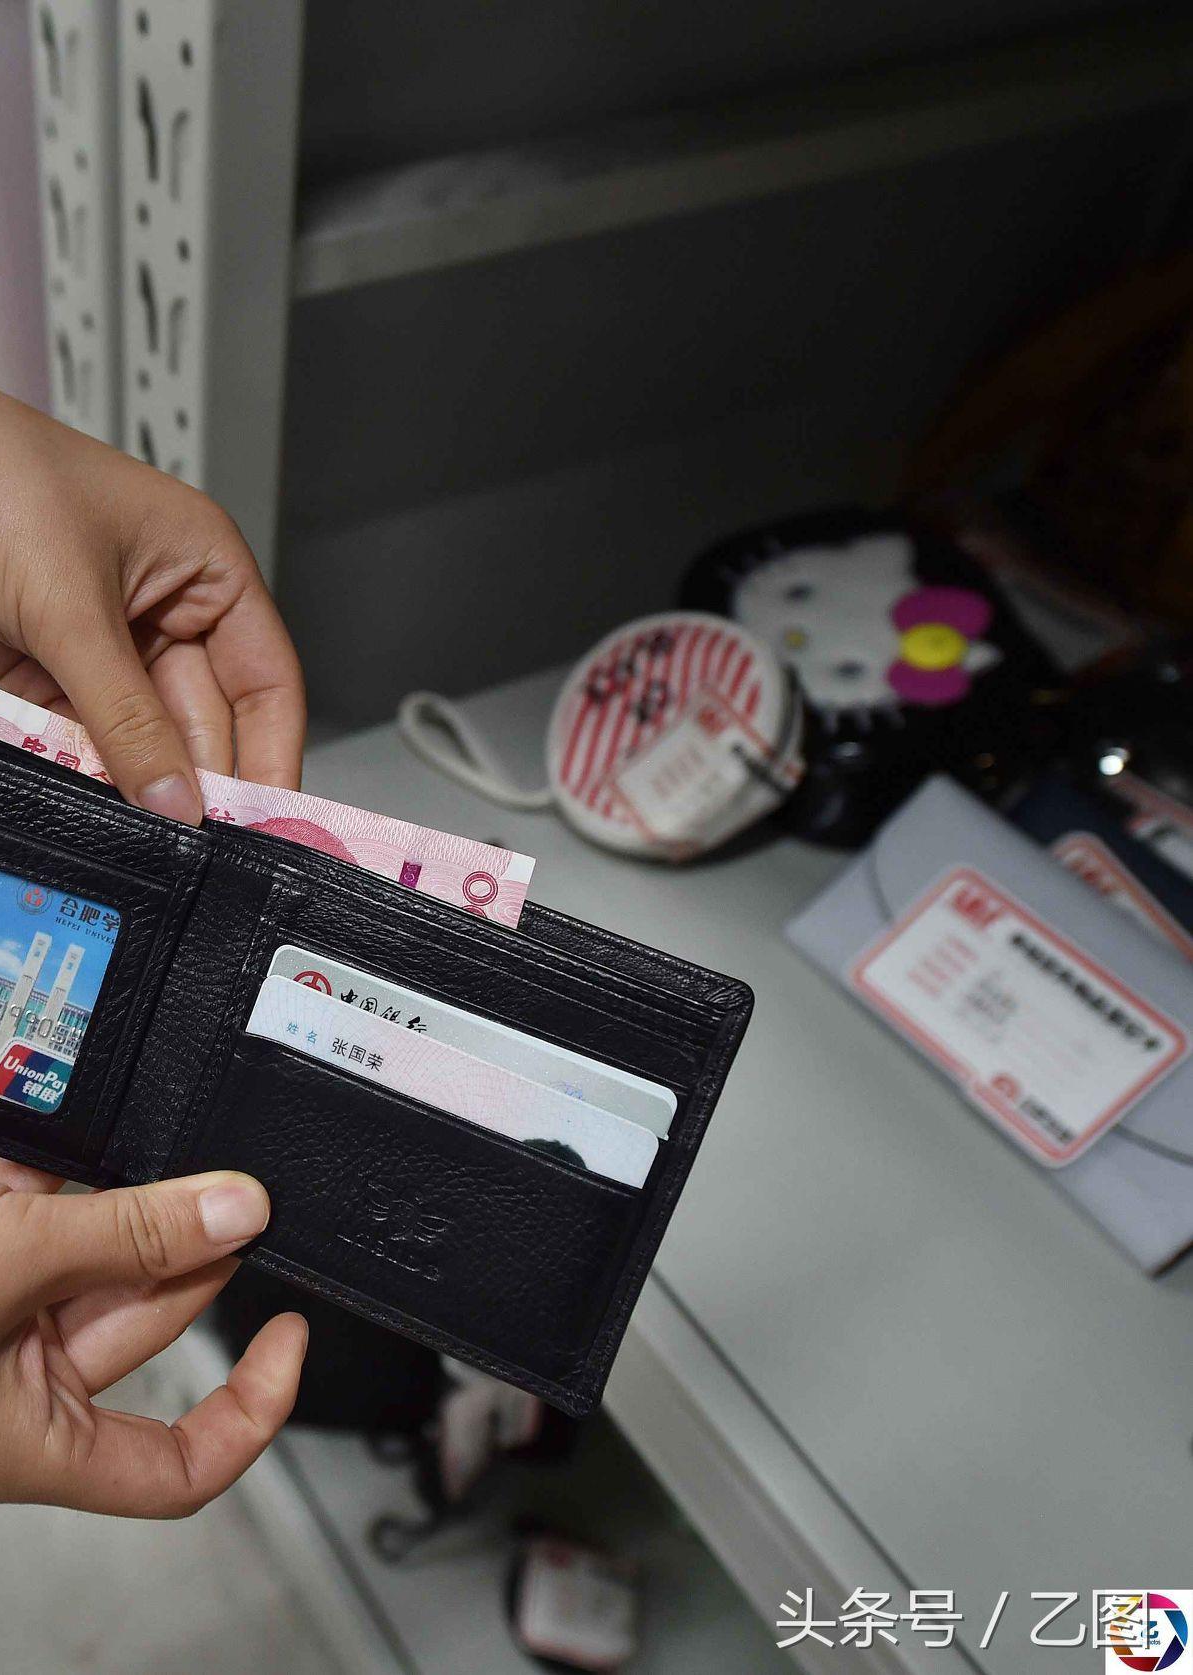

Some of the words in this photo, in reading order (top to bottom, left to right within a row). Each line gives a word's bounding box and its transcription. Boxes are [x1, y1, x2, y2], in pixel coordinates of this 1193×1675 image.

[55, 916, 81, 931] HEFEI
[286, 1022, 318, 1045] 姓名
[331, 1037, 384, 1072] 张国荣
[22, 1080, 60, 1104] 银联
